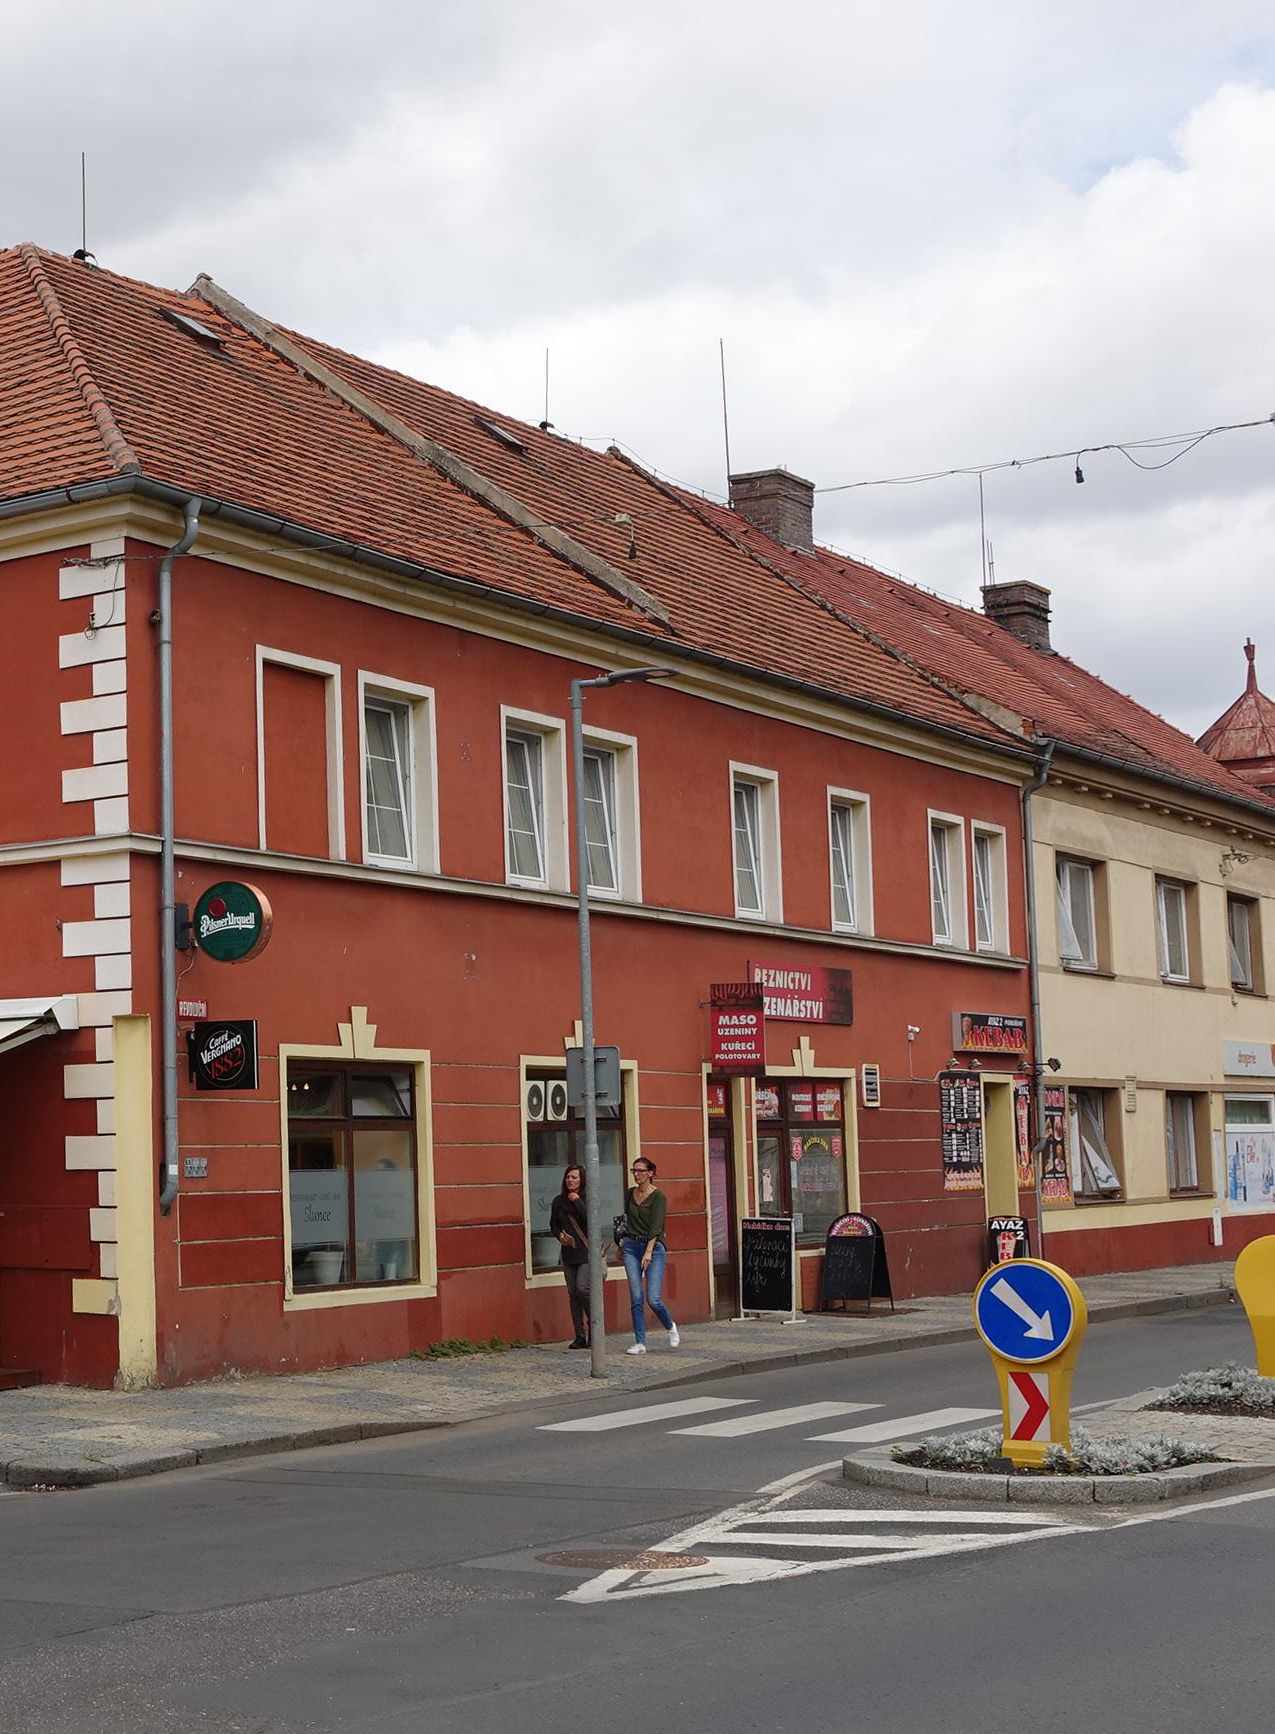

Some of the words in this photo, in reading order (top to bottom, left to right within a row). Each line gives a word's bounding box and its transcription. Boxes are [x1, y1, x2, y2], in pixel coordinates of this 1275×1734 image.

[200, 914, 229, 938] Pilsner
[227, 911, 255, 930] Urquell
[764, 993, 823, 1019] ZENÁŘSTVÍ
[718, 1014, 757, 1026] MASO
[717, 1027, 758, 1036] UZENINY
[973, 1025, 1026, 1048] KEBAB
[200, 1034, 242, 1065] VERGNANO
[721, 1041, 756, 1051] KUŘECÍ
[211, 1046, 243, 1079] 1882
[990, 1220, 1024, 1230] AYAZ
[1016, 1231, 1024, 1240] 2
